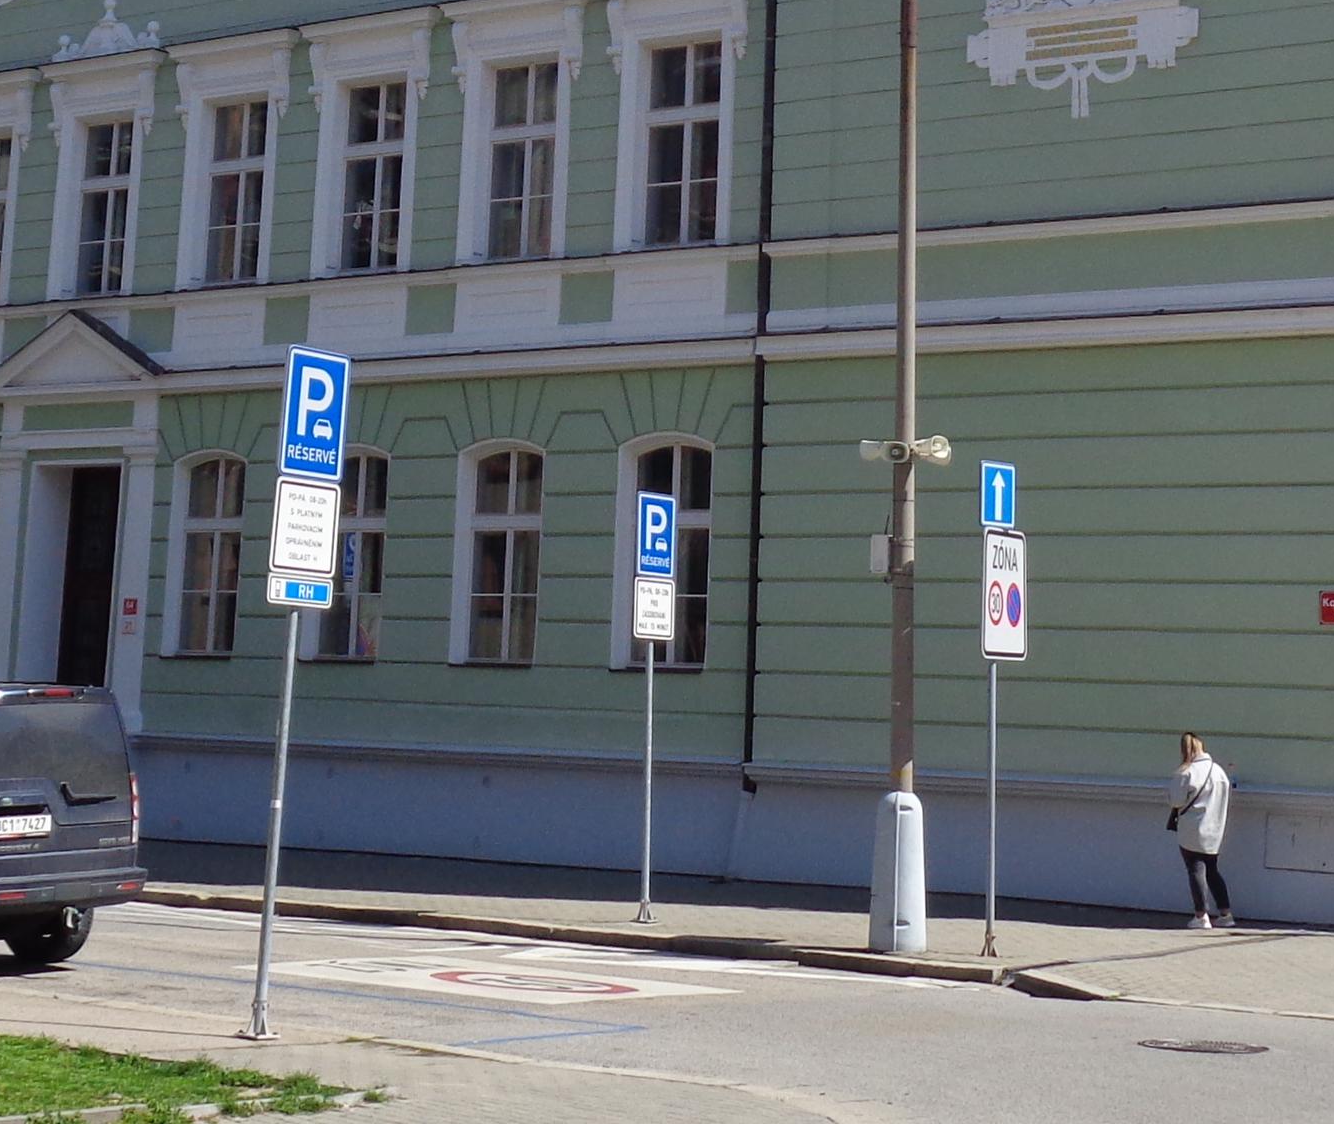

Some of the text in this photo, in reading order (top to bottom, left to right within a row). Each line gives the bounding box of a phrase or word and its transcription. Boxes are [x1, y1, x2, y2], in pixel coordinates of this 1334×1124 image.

[297, 366, 334, 436] P
[287, 442, 337, 465] RÉSERVÉ
[645, 504, 667, 550] P
[992, 539, 1018, 572] ZÓNA
[298, 584, 315, 599] RH
[992, 593, 1001, 614] 30
[22, 816, 46, 831] 7427
